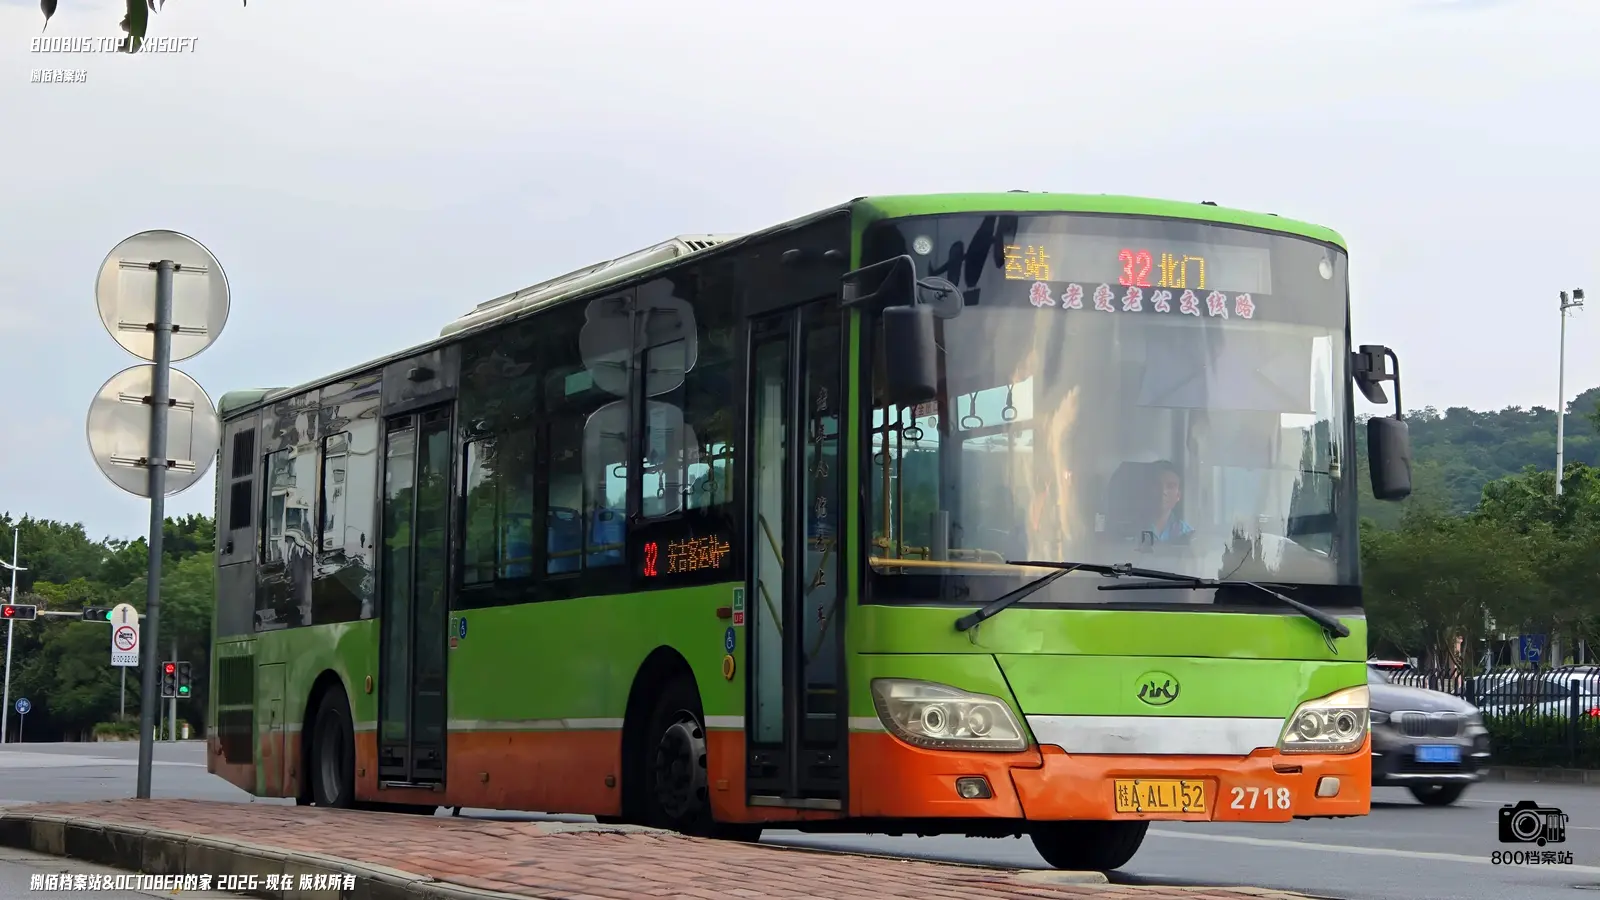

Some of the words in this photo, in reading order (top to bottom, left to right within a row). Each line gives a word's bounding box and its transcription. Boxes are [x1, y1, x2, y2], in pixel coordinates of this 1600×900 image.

[1118, 248, 1153, 289] 32
[1157, 253, 1205, 290] 北门
[1028, 281, 1256, 319] 敬老爱老公交线路
[644, 542, 658, 577] 32
[666, 534, 720, 574] 安吉客运站
[734, 590, 743, 607] 上
[734, 613, 743, 623] UP
[1230, 787, 1291, 810] 2718
